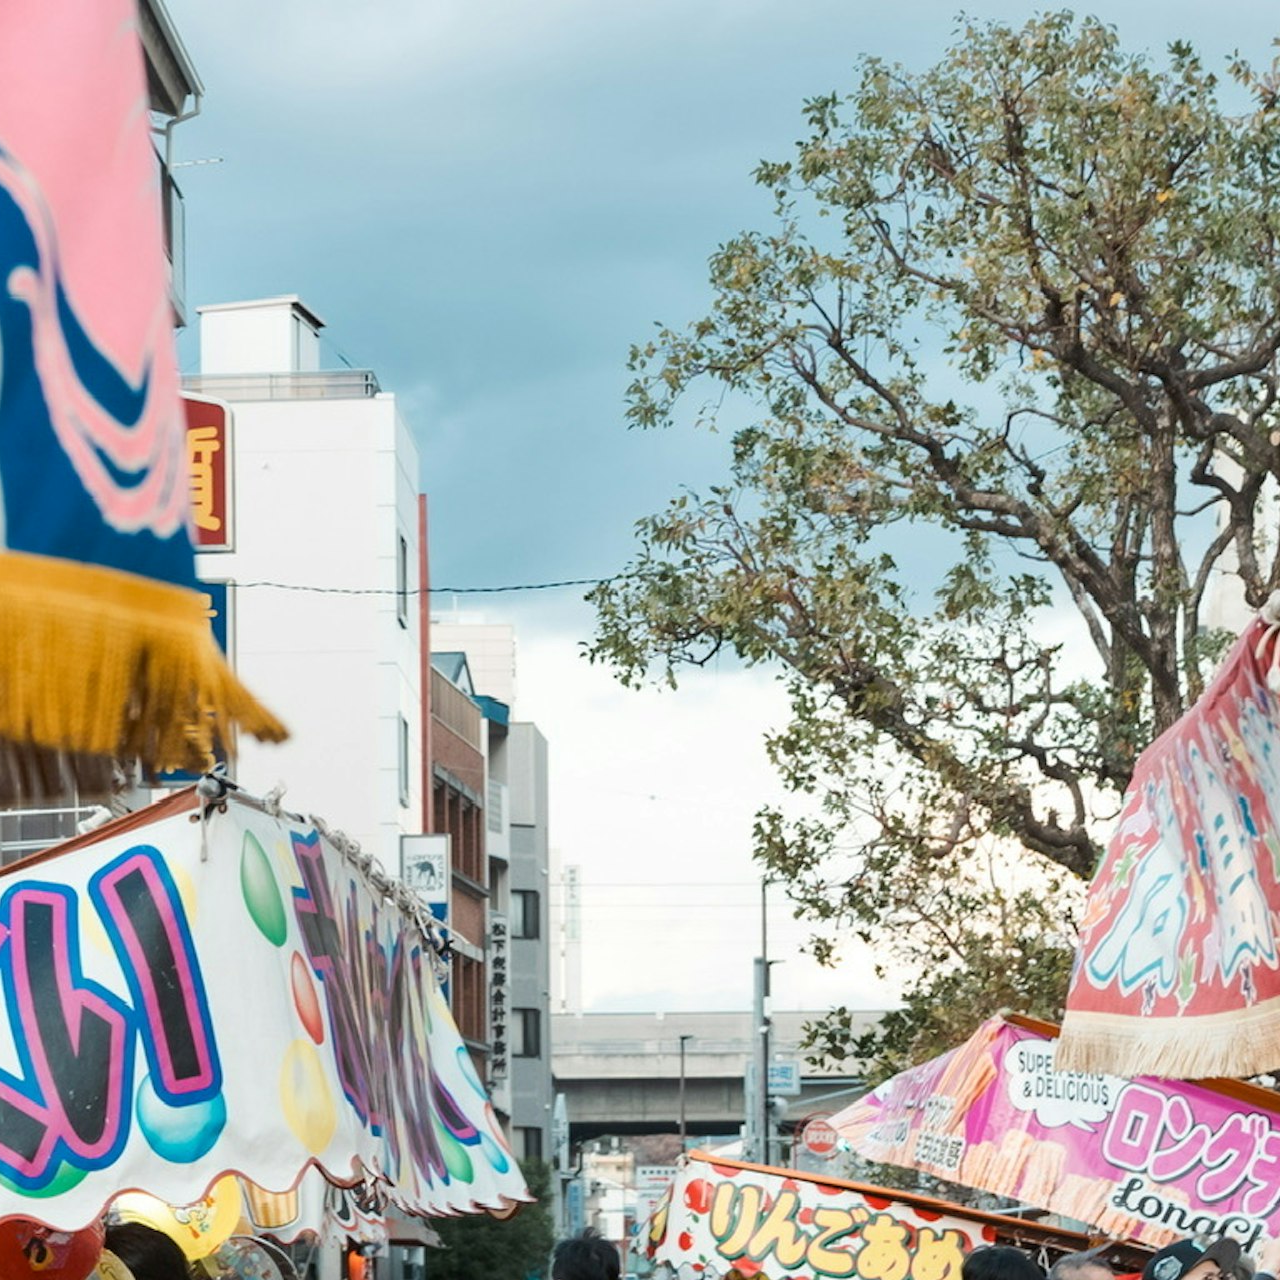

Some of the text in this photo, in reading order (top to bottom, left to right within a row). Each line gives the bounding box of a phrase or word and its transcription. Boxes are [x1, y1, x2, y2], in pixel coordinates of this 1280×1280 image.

[492, 923, 507, 1073] 松下税務会計事務所
[1018, 1051, 1063, 1076] SUPE
[1035, 1076, 1109, 1105] DELICIOUS
